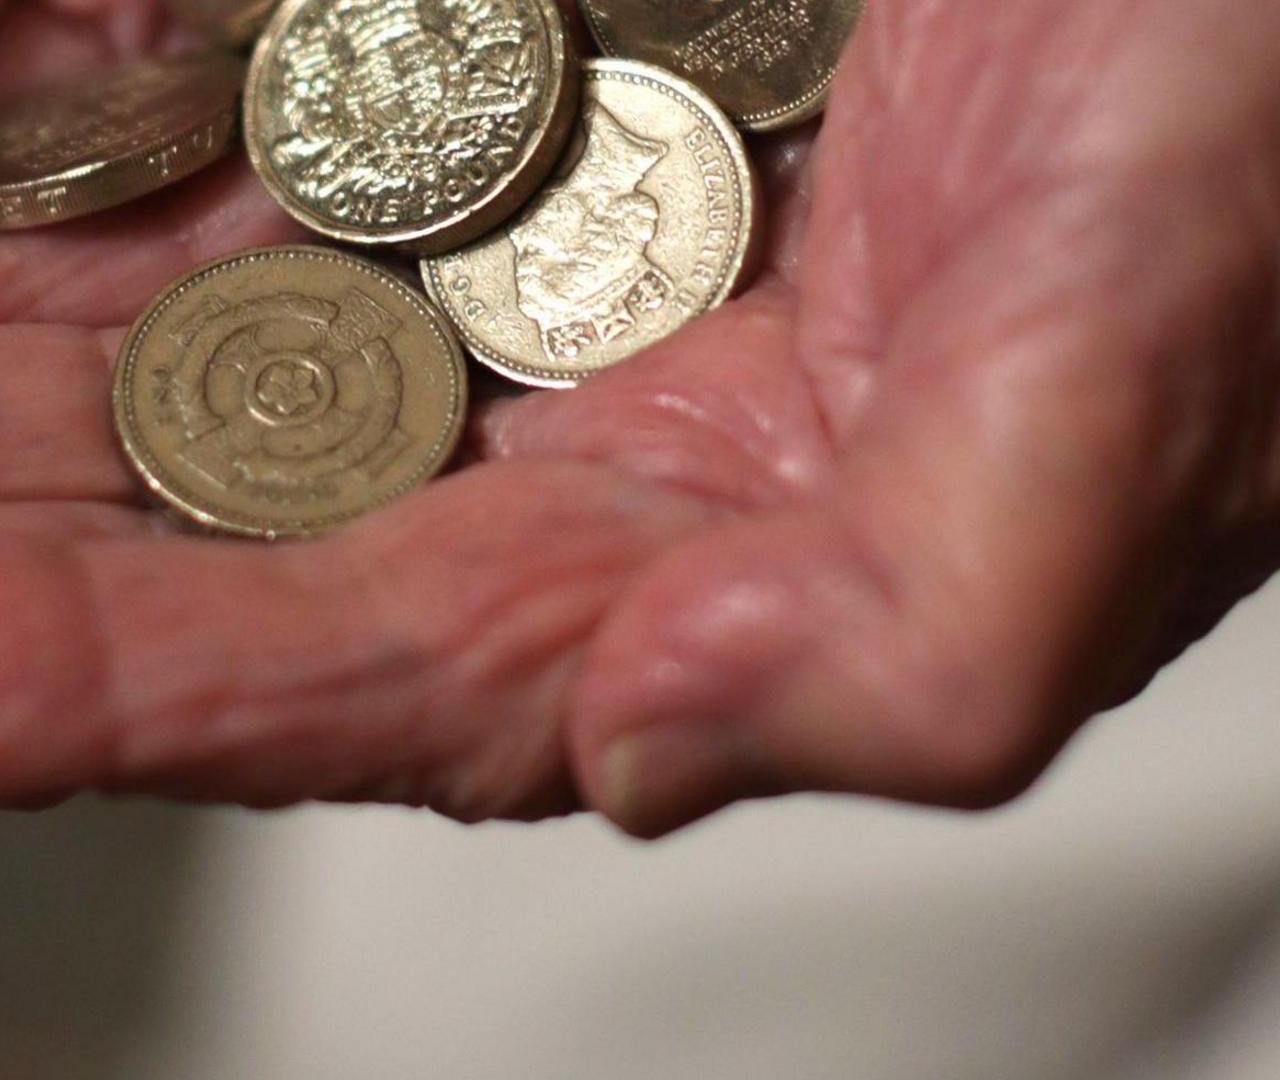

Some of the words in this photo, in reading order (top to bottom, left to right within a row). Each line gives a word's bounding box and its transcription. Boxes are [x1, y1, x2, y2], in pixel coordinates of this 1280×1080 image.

[331, 190, 399, 223] ONE
[423, 116, 524, 216] POUND
[684, 128, 730, 286] ELIZABETH
